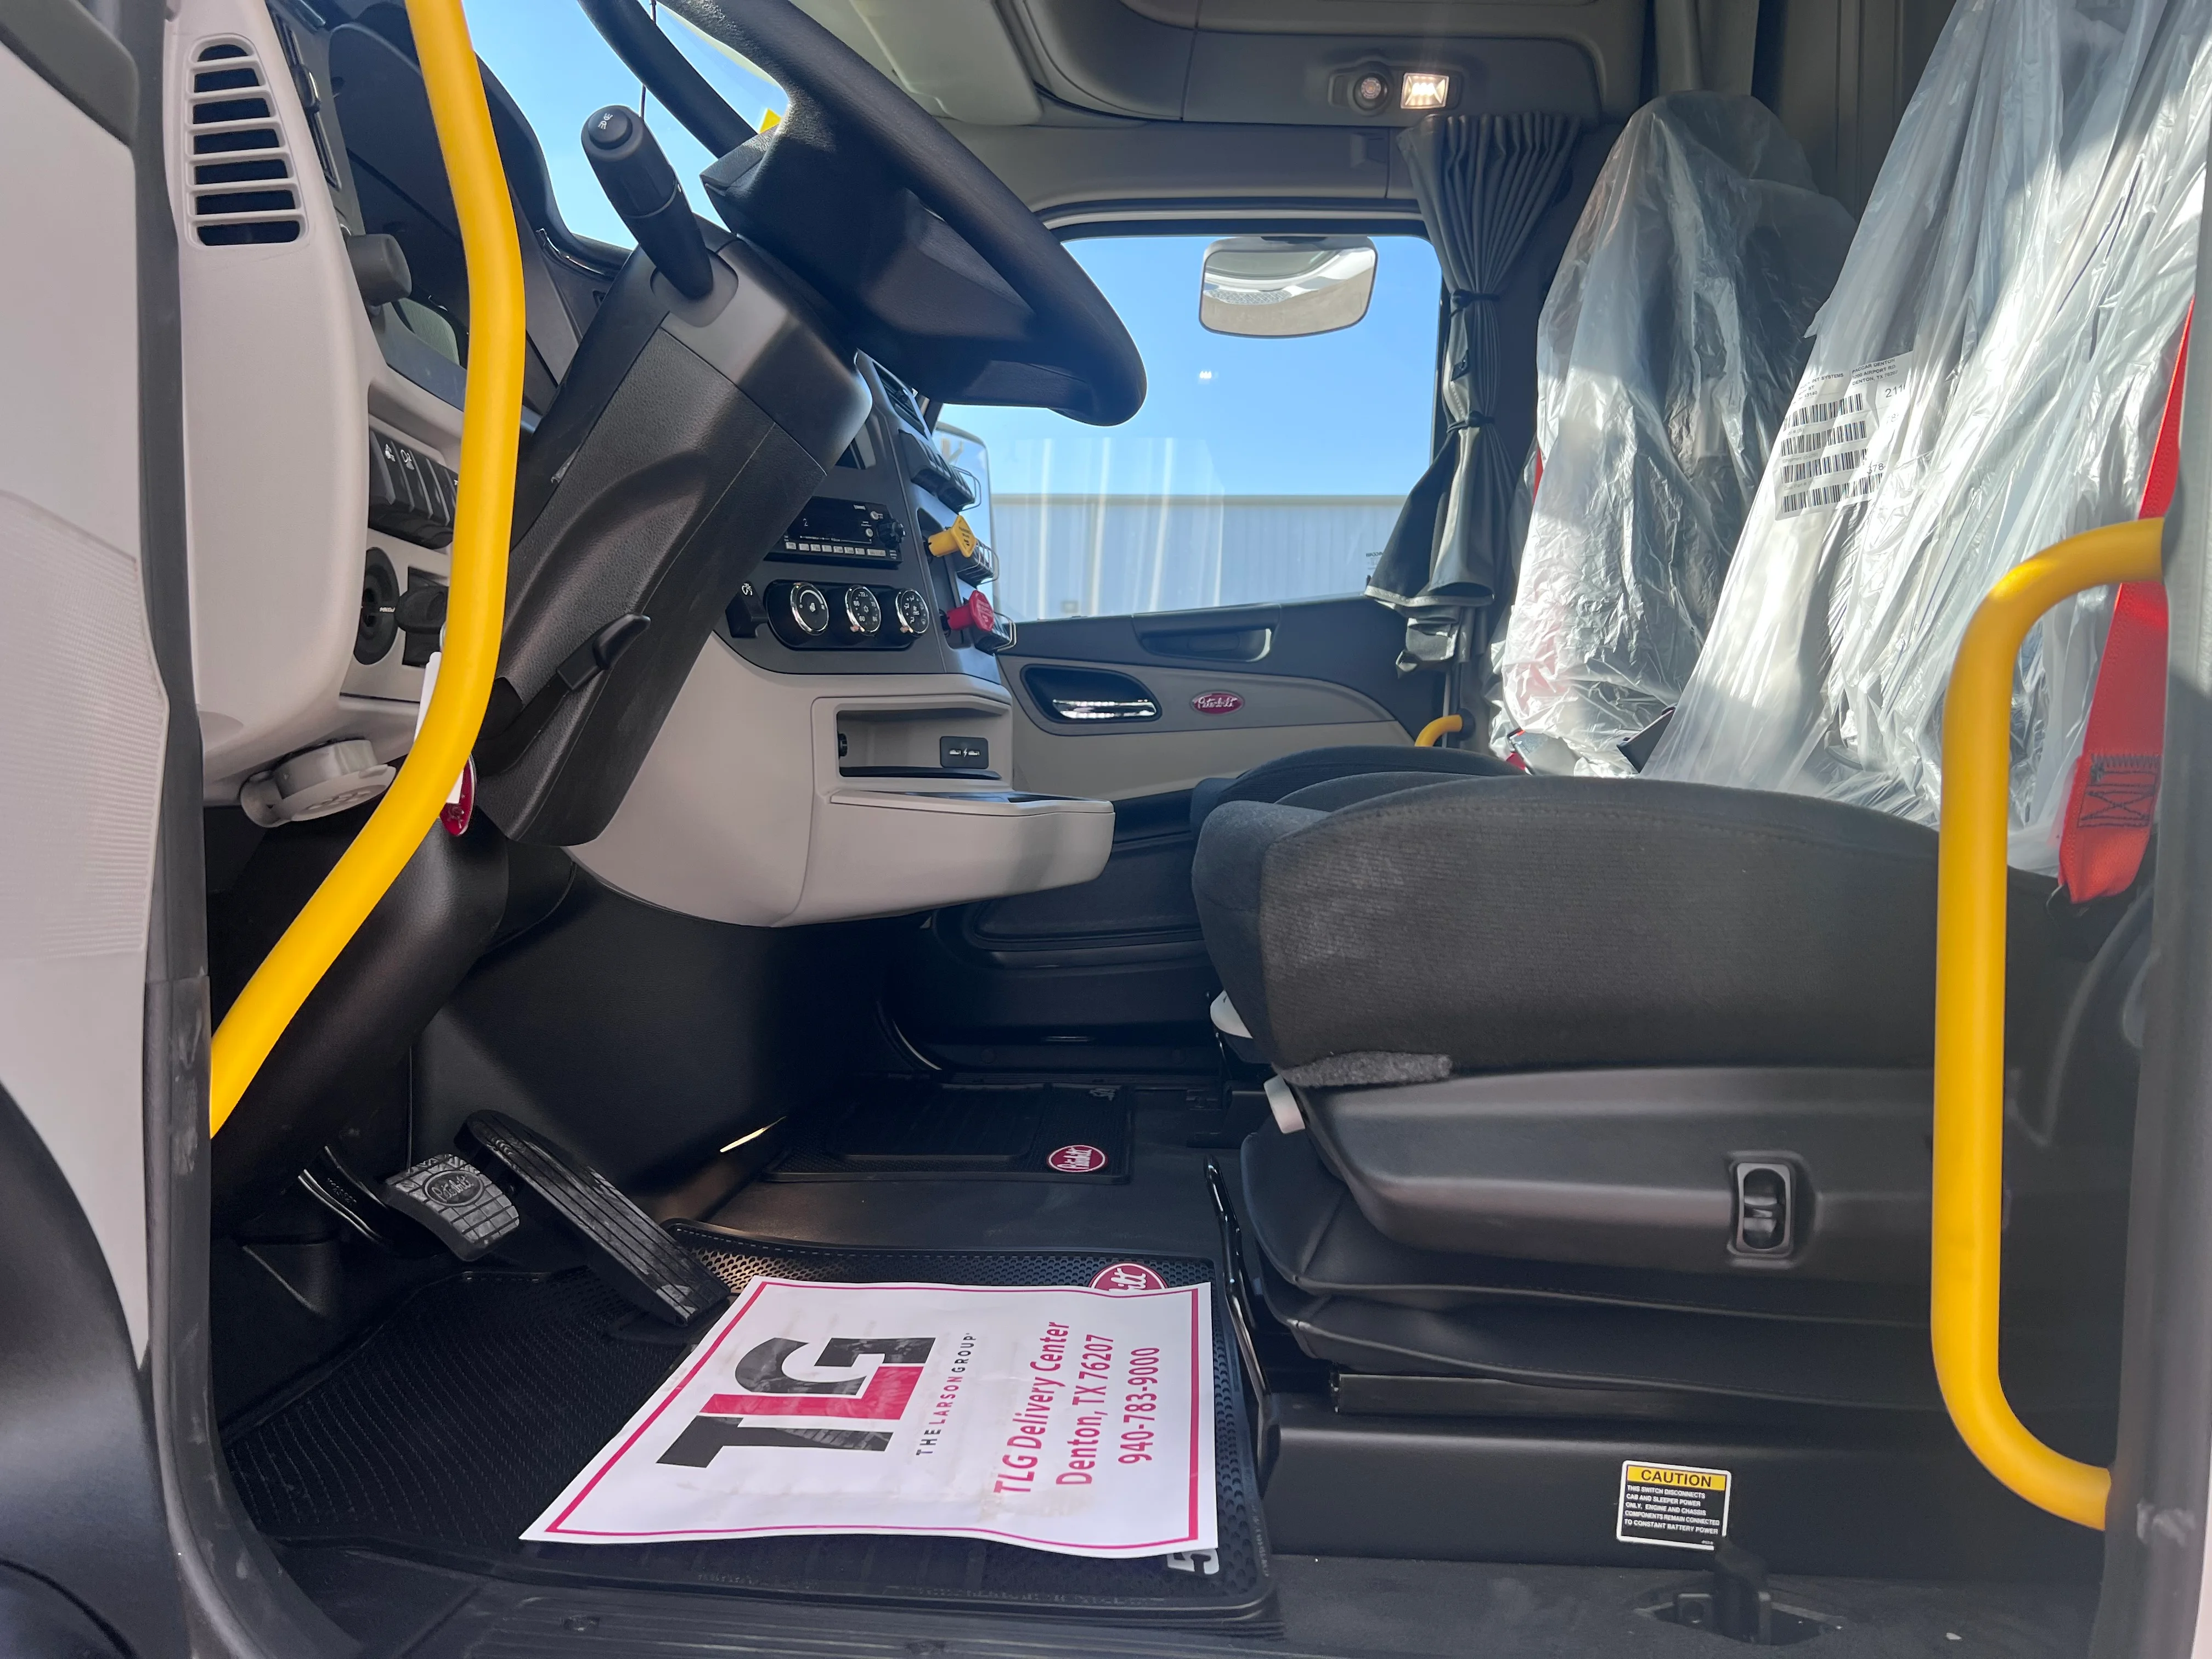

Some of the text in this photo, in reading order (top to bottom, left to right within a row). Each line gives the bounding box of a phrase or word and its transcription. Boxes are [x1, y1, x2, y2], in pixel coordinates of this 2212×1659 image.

[1852, 358, 1895, 374] PACCAR DENTON
[1864, 367, 1887, 376] AIRPORT
[431, 1176, 475, 1204] Peterbilt
[656, 1337, 936, 1469] TLG
[916, 1335, 977, 1455] THE LARSON GROUP
[994, 1321, 1069, 1493] TLG Delivery Center
[1056, 1334, 1114, 1485] Denton, TX 76207
[1118, 1347, 1160, 1464] 940-783-9000
[1641, 1469, 1712, 1487] CAUTION
[1641, 1486, 1663, 1494] SWITCH
[1664, 1488, 1706, 1499] DISCONNECTS
[1652, 1496, 1679, 1504] SLEEPER
[1624, 1510, 1720, 1526] COMPONENTS REMAIN CONNECTED
[1681, 1508, 1706, 1516] CHASSIS
[1633, 1520, 1666, 1529] CONSTANT
[1667, 1523, 1694, 1532] BATTERY
[1695, 1527, 1718, 1535] POWER
